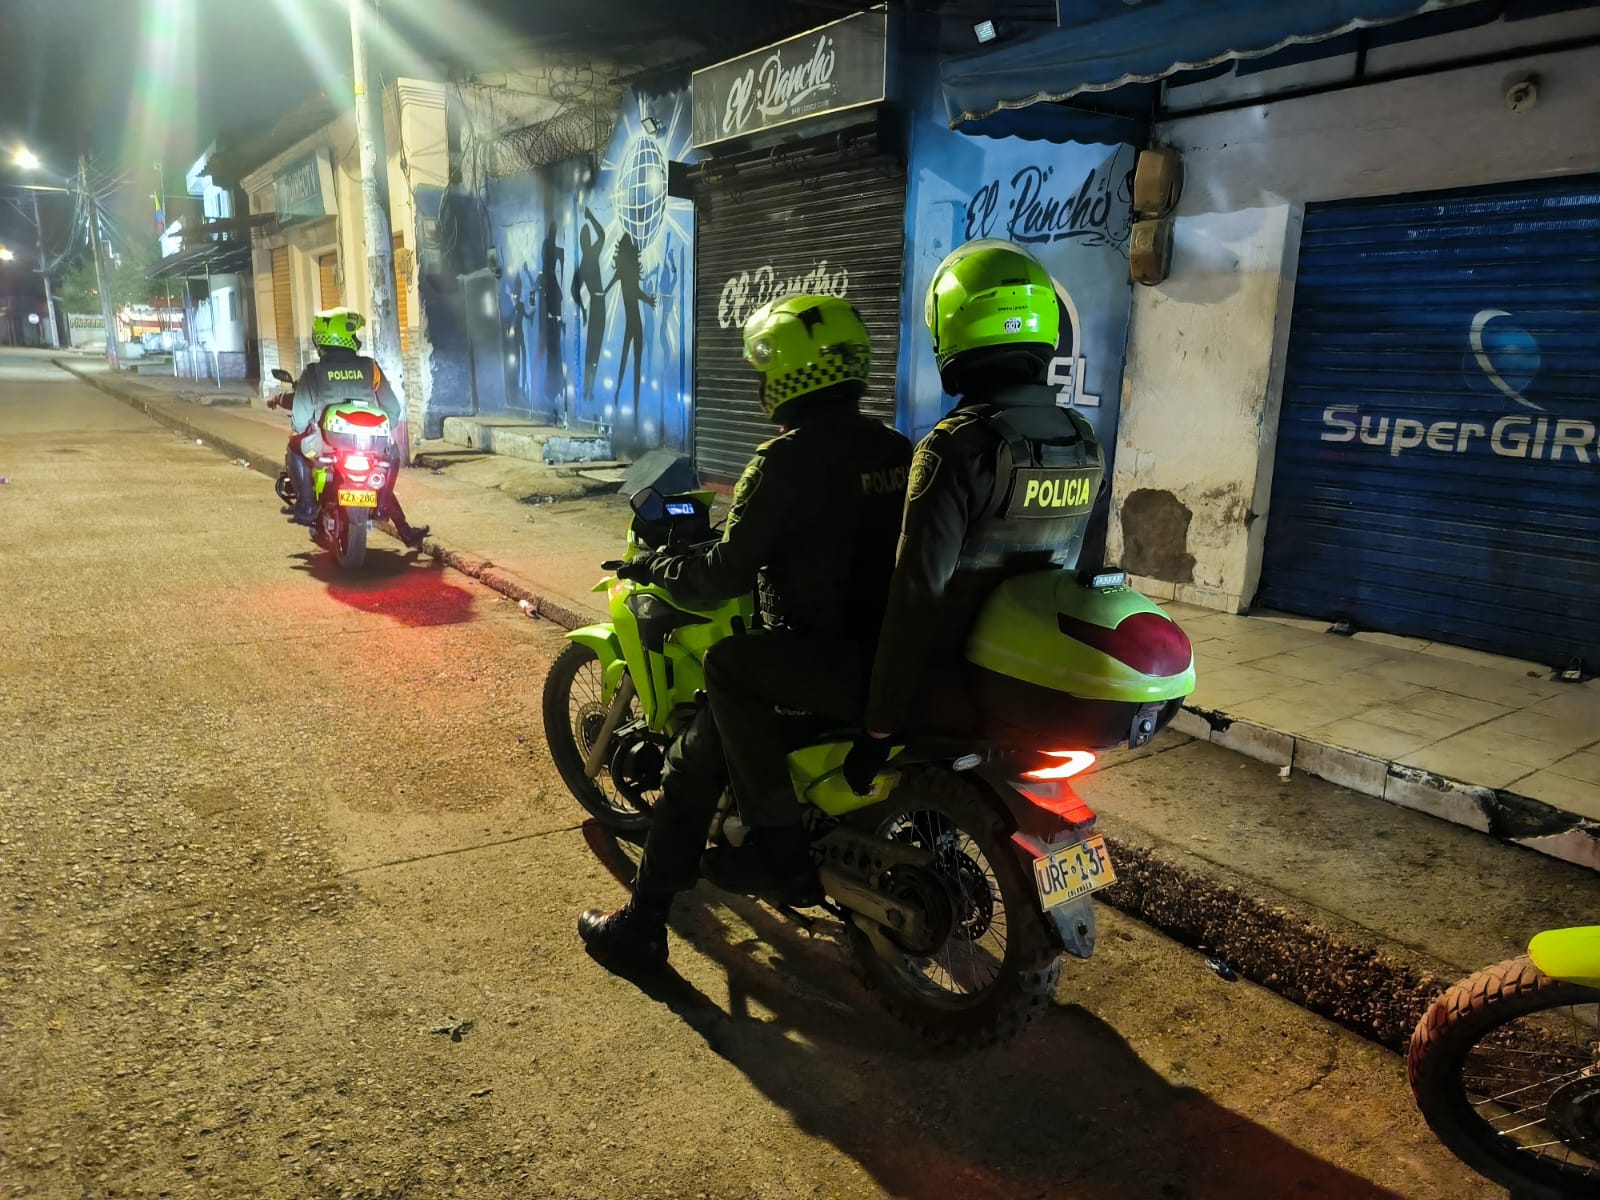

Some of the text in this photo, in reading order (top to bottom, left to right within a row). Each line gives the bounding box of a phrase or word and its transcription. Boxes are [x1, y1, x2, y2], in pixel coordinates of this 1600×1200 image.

[327, 370, 364, 381] POLICIA
[1320, 404, 1600, 463] SuperGIR
[861, 465, 908, 494] POLIC
[1024, 478, 1090, 507] POLICIA
